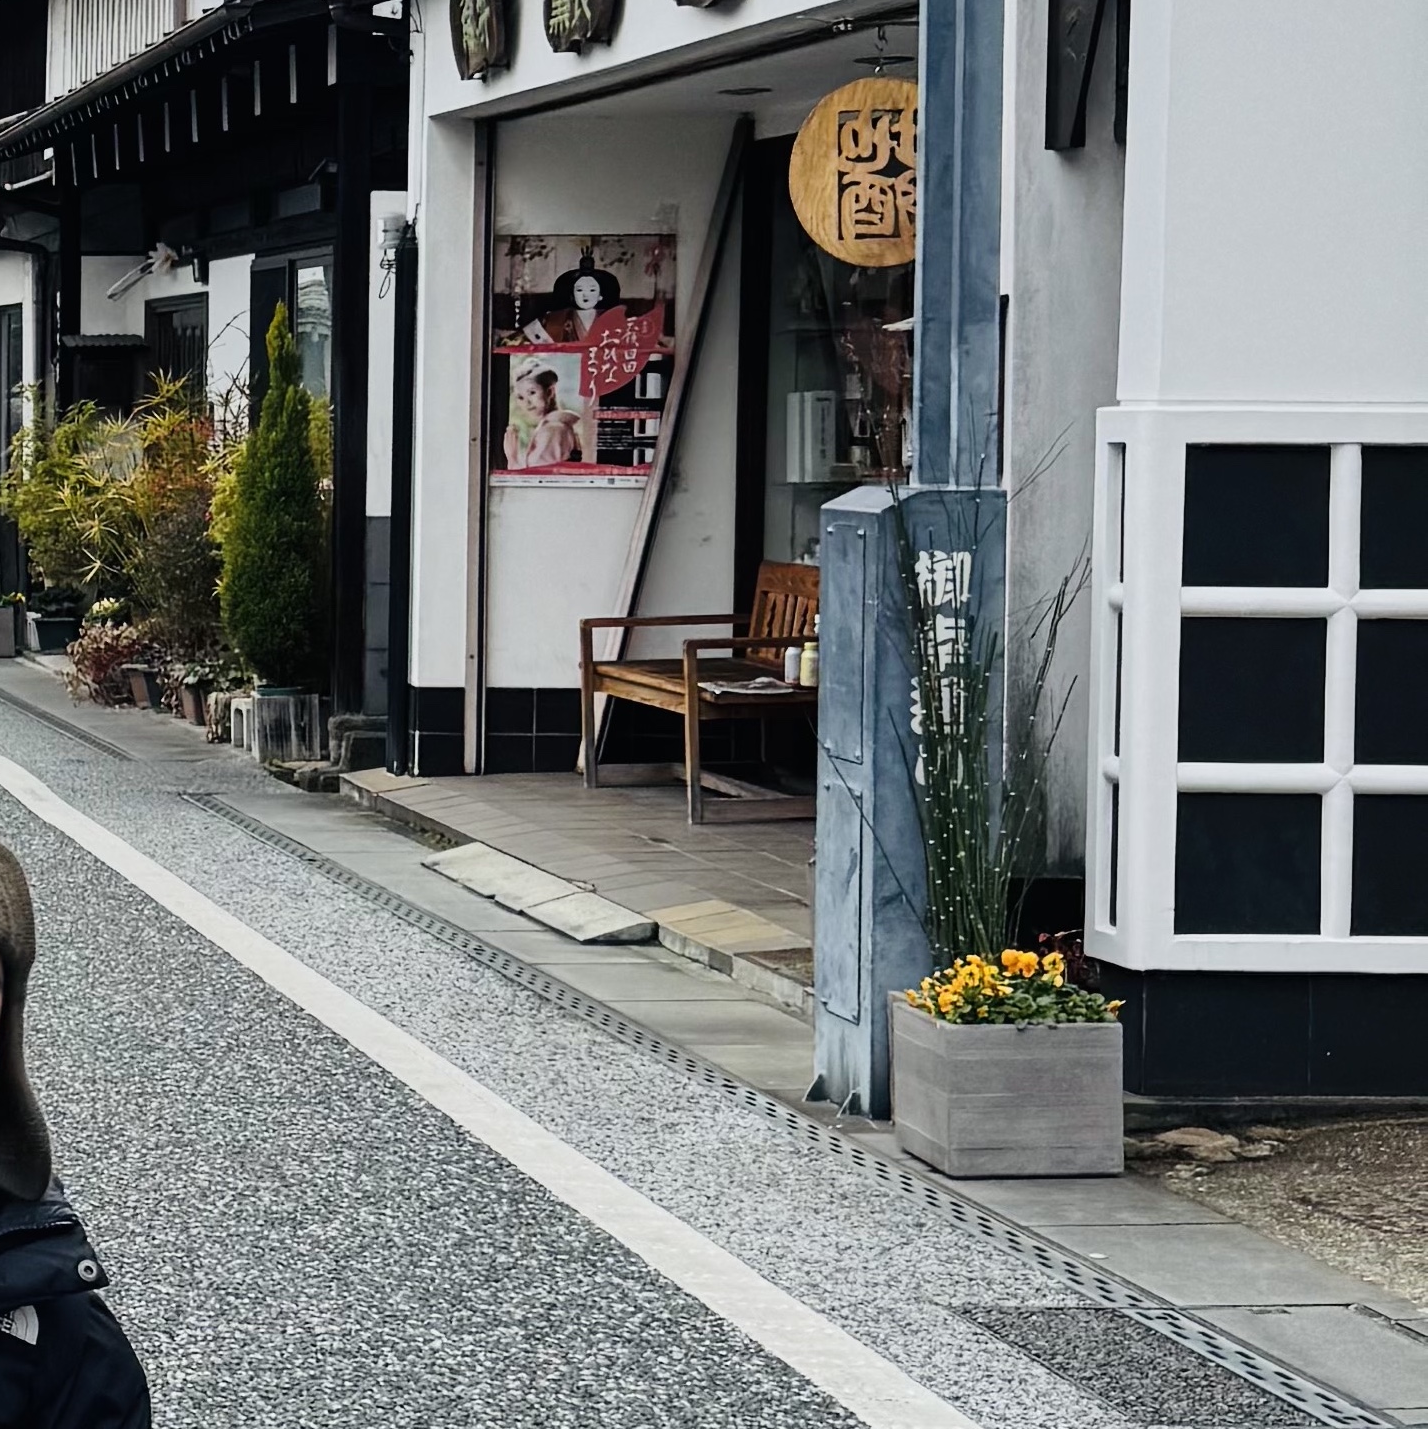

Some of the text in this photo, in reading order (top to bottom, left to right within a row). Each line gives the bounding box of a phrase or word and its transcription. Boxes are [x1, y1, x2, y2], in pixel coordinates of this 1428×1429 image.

[587, 346, 599, 407] まつり
[599, 328, 622, 383] おひな
